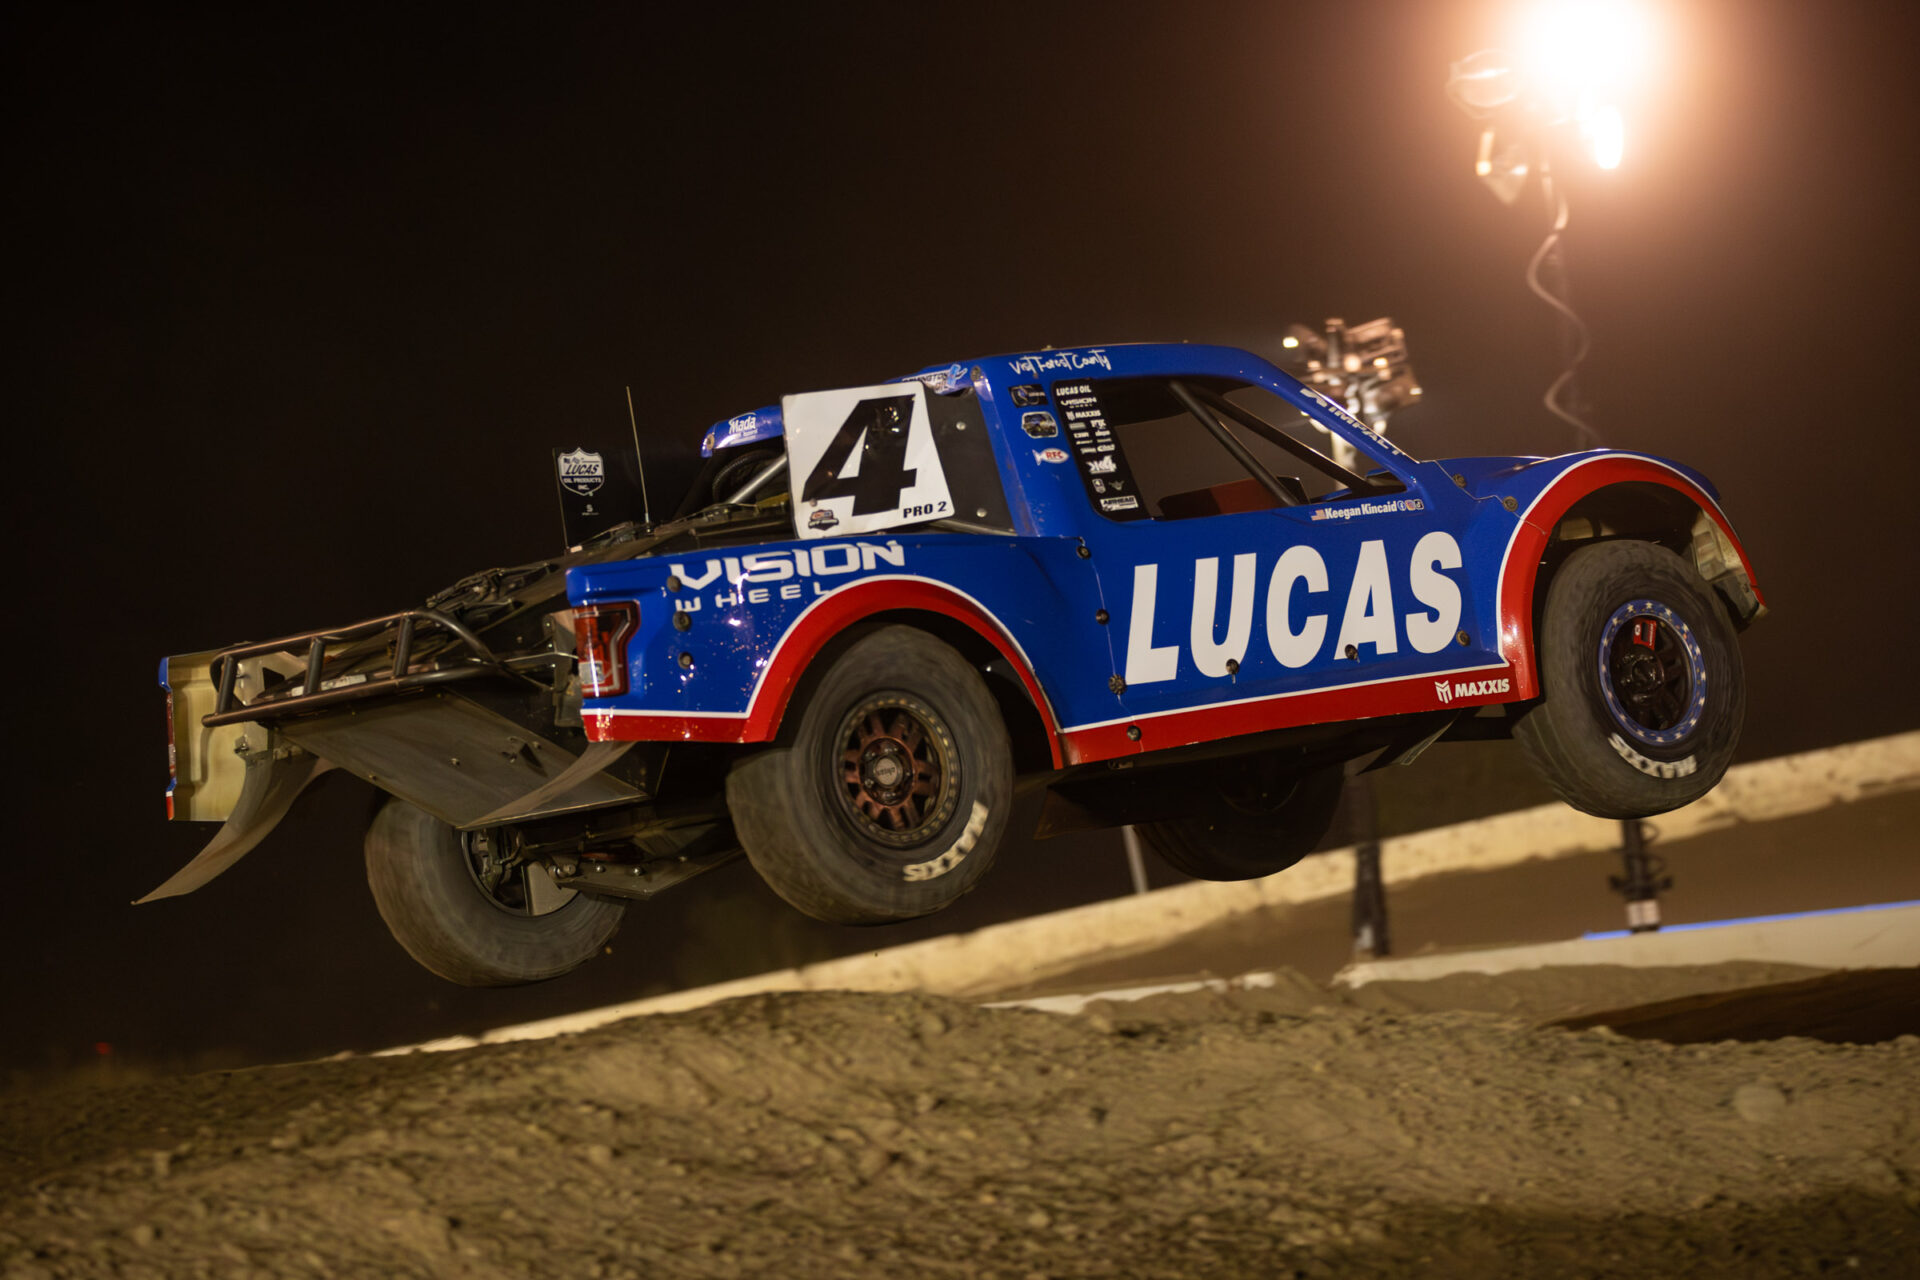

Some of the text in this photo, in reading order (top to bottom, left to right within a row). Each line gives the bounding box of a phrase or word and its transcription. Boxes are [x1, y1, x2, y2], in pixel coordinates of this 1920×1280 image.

[1009, 349, 1112, 375] Visit Forest County
[1056, 386, 1079, 397] LUCAS
[1079, 384, 1092, 394] OIL
[728, 414, 757, 435] Mada
[802, 394, 917, 518] 4
[565, 463, 600, 475] LUCAS
[903, 501, 947, 518] PRO 2
[1325, 501, 1398, 520] Keegan Kincaid
[669, 540, 905, 591] VISION
[1125, 531, 1462, 685] LUCAS
[1455, 678, 1511, 698] MAXXIS
